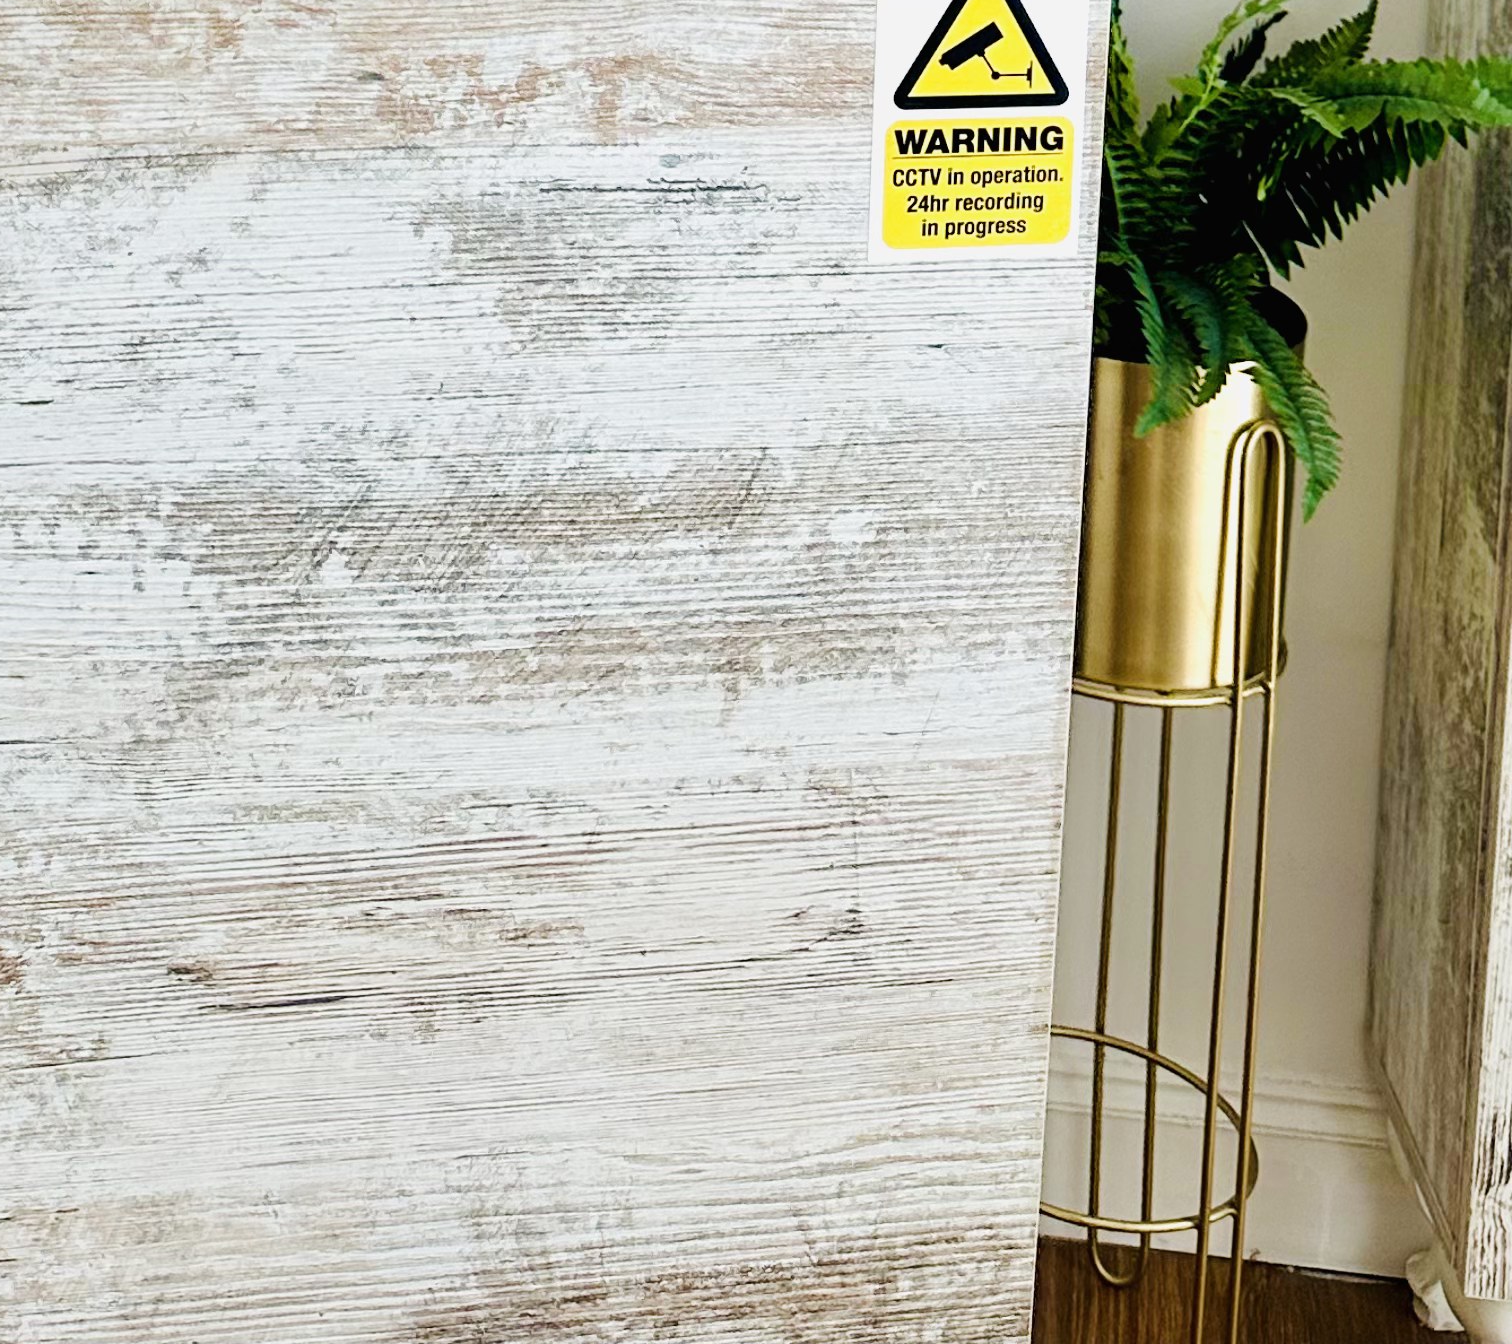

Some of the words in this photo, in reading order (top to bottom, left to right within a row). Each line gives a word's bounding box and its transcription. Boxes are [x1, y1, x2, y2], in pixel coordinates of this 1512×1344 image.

[895, 126, 1064, 155] WARNING
[893, 169, 942, 187] CCTV
[948, 168, 964, 185] in
[971, 165, 1064, 188] operation.
[907, 195, 949, 213] 24hr
[955, 192, 1044, 212] recording
[922, 219, 938, 236] in
[945, 219, 1027, 239] progress
